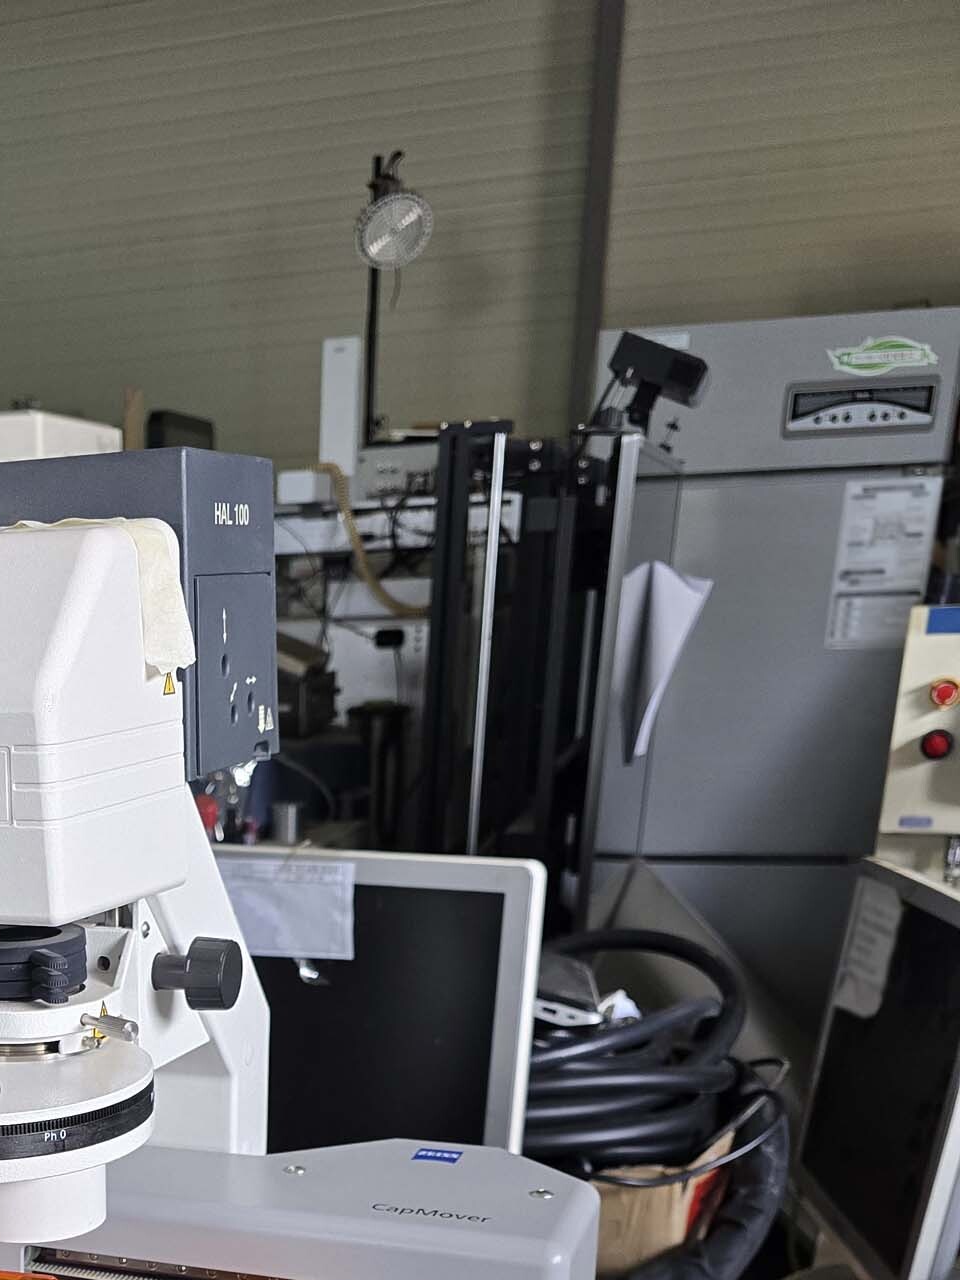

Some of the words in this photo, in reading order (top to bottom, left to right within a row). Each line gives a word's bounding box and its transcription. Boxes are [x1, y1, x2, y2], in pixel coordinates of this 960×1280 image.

[214, 501, 233, 525] HAL
[233, 503, 250, 526] 100
[44, 1132, 57, 1142] Ph
[371, 1203, 493, 1222] CapMover
